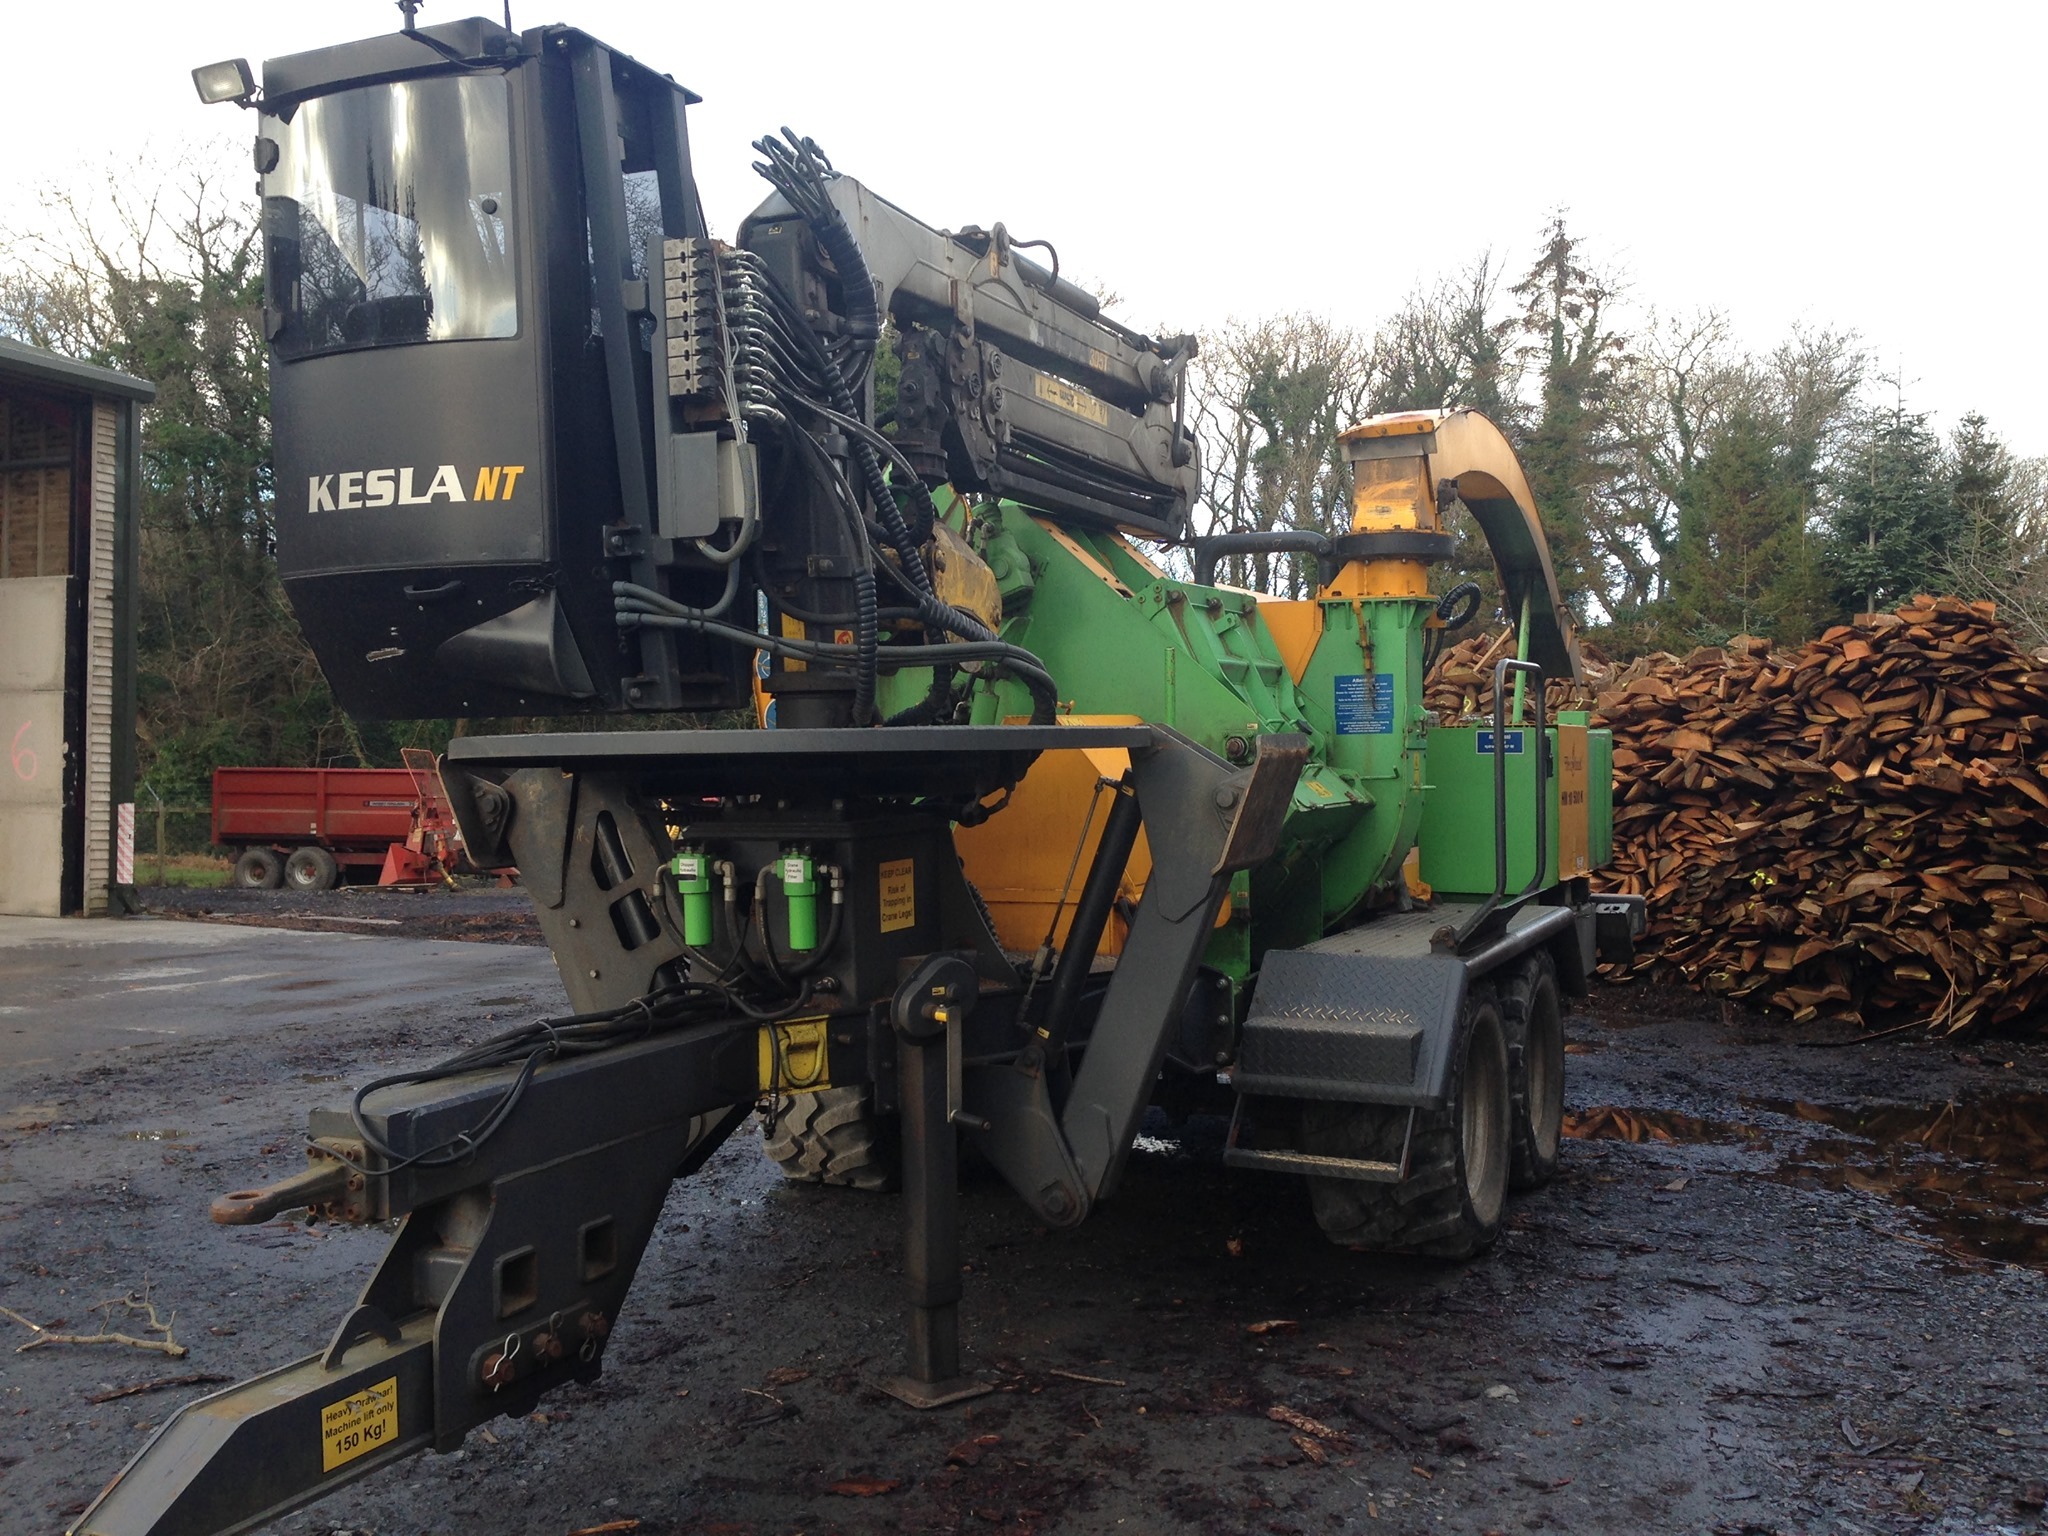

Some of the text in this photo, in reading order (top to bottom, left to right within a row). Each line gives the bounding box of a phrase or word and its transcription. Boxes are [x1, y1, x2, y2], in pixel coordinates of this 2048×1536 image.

[308, 464, 524, 513] KESLA NT
[11, 720, 38, 781] 6
[880, 866, 912, 879] KEEP CLEAR
[888, 883, 906, 895] Risk of
[883, 897, 906, 907] Trapping
[882, 908, 912, 922] Crane Legs!
[325, 1402, 394, 1440] Machine lift only
[326, 1406, 352, 1424] Heavy
[335, 1419, 386, 1454] 150 Kg!
